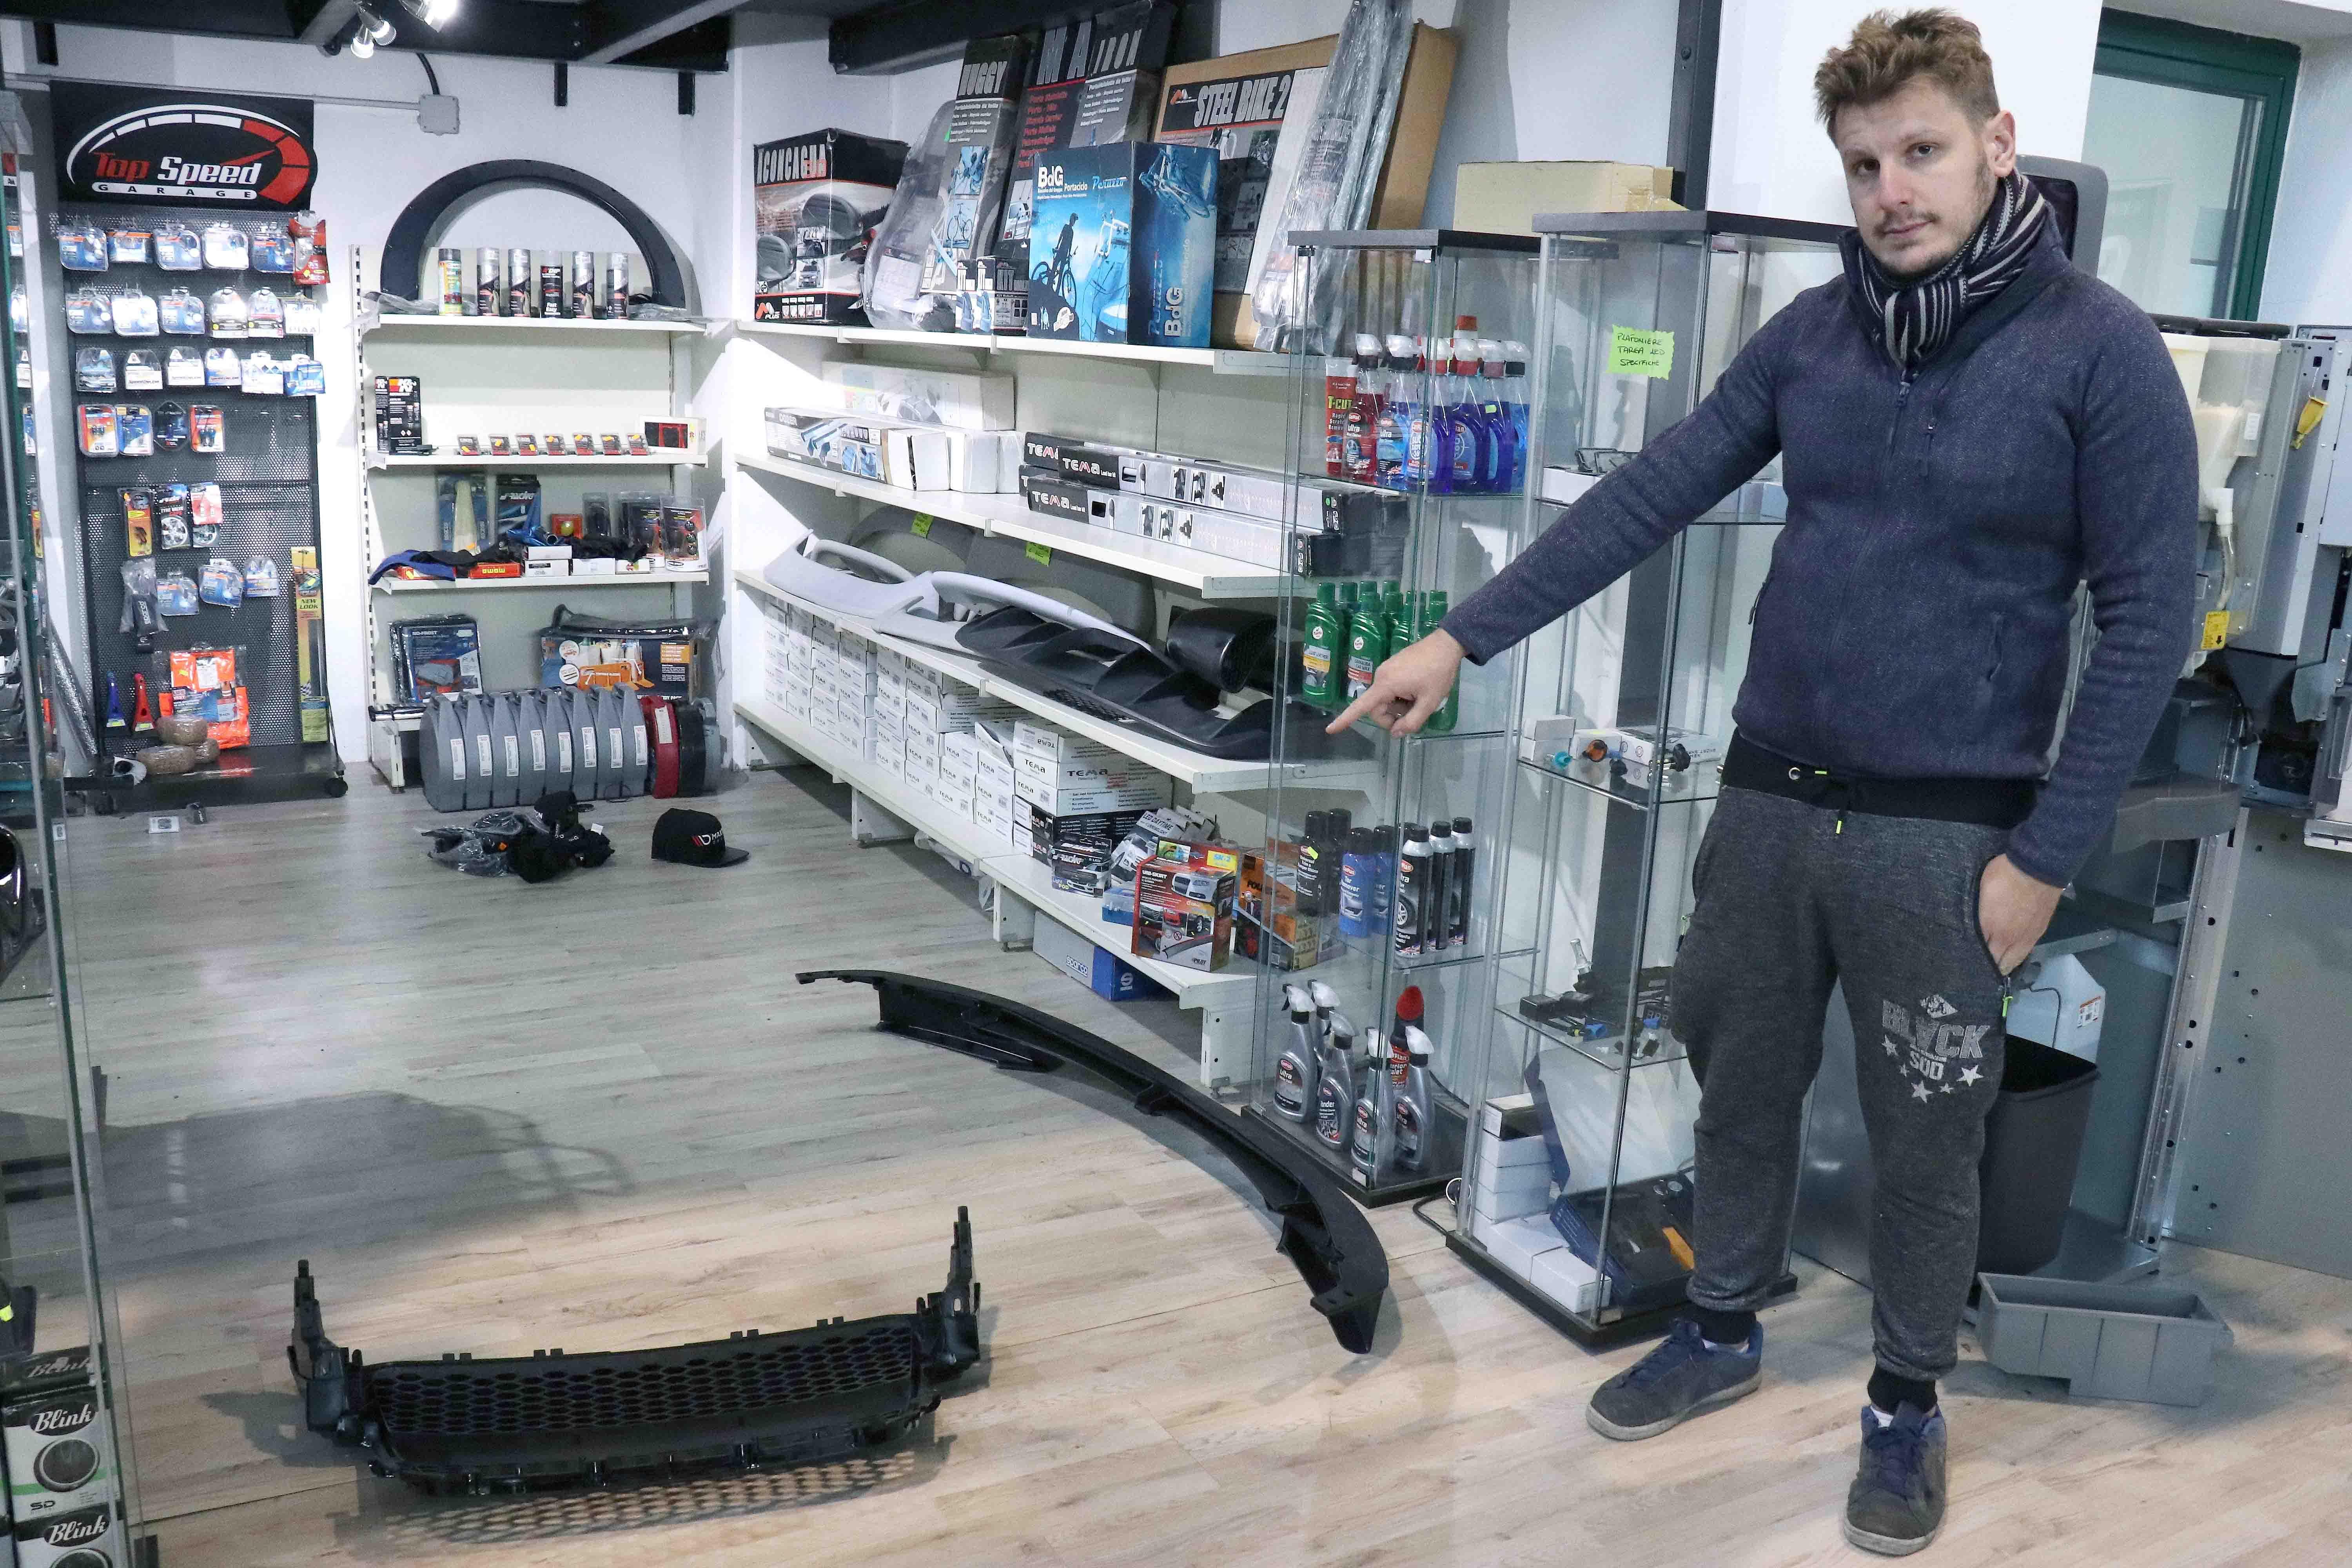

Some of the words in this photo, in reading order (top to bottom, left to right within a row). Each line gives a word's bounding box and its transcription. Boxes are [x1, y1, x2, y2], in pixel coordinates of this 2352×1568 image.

[1194, 82, 1239, 127] STEEL
[1234, 77, 1279, 122] BIKE
[1272, 75, 1291, 118] 2
[94, 152, 151, 182] Top
[157, 156, 262, 185] Speed
[1038, 165, 1063, 187] BdG
[98, 183, 251, 198] GARAGE
[1064, 182, 1088, 192] Portaciclo
[1164, 287, 1183, 336] BdG
[1143, 811, 1154, 821] LED
[1151, 816, 1174, 831] DAYTIME
[1066, 955, 1088, 975] sparco
[34, 1403, 93, 1433] Blink
[49, 1515, 109, 1547] Blink
